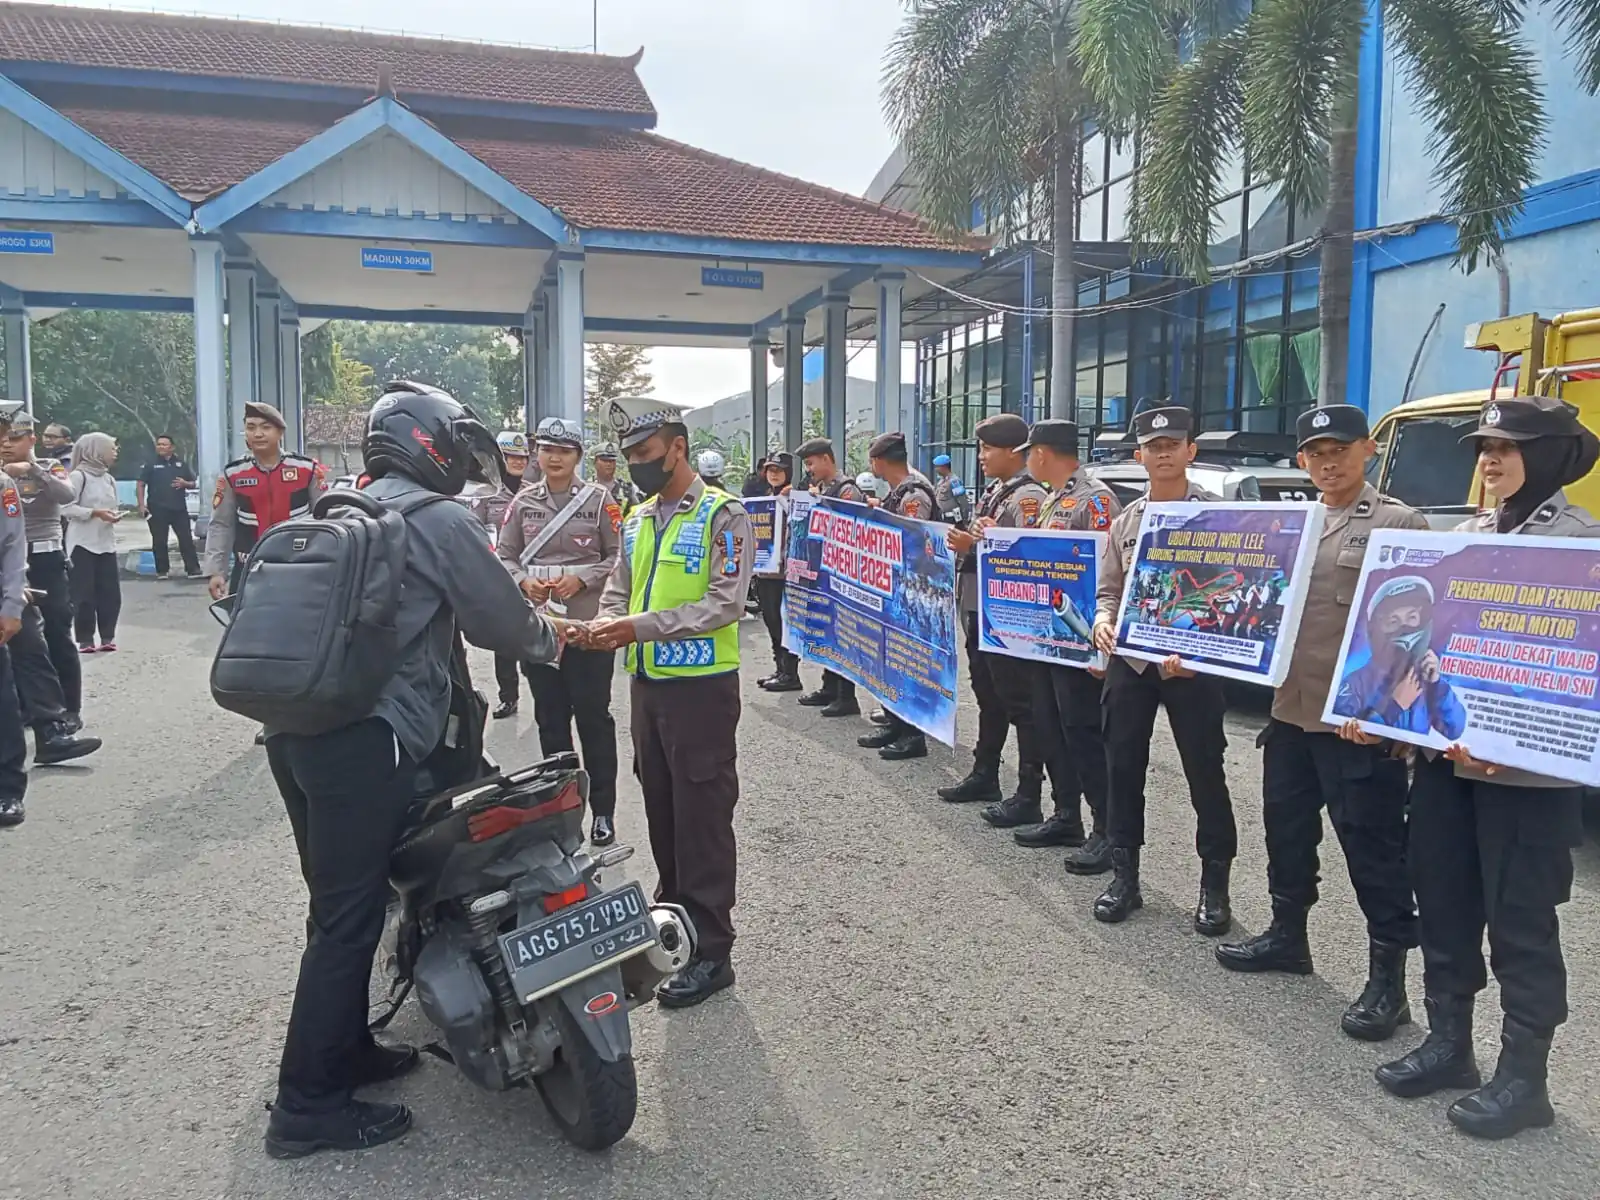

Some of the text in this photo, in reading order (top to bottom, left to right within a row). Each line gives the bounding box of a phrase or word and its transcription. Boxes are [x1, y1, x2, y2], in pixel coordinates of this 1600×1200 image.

[364, 253, 430, 265] MADIUN 30KM
[830, 516, 902, 563] KESELAMATAN
[1168, 531, 1266, 550] UBUR UBUR IWAK LELE
[823, 540, 859, 580] SEMERU
[860, 555, 891, 593] 2025
[988, 557, 1087, 572] KNALPOT TIDAK SESUAI
[1236, 553, 1265, 567] MOTOR
[995, 566, 1078, 581] SPESIFIKASI TEKNIS
[989, 580, 1036, 602] DILARANG
[1447, 580, 1517, 604] PENGEMUDI
[1517, 585, 1546, 607] DAN
[1479, 610, 1578, 639] SEPEDA MOTOR
[1449, 636, 1596, 671] JAUH ATAU DEKAT WAJIB
[1440, 657, 1596, 697] MENGGUNAKAN HELM SNI
